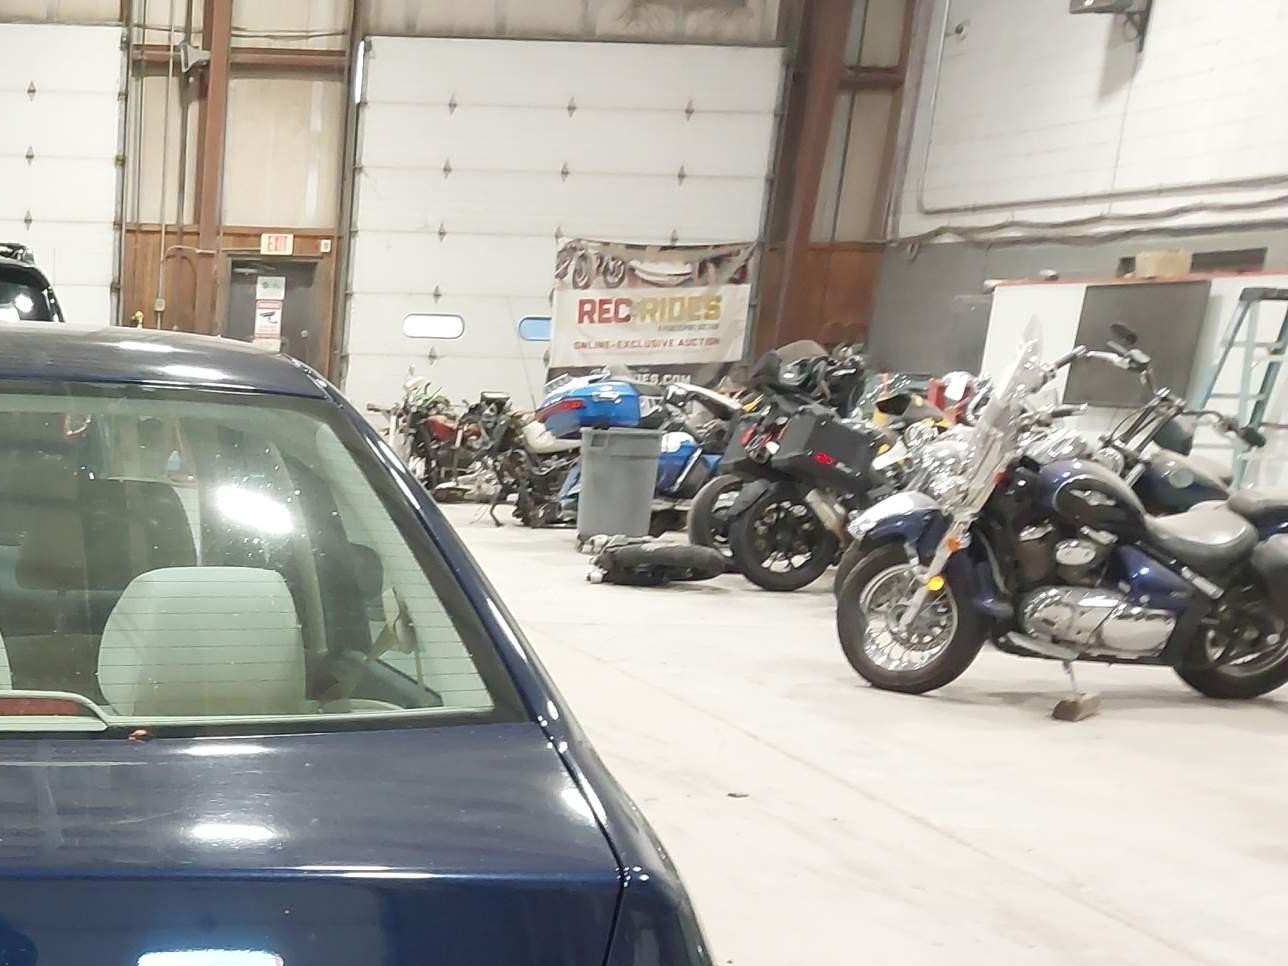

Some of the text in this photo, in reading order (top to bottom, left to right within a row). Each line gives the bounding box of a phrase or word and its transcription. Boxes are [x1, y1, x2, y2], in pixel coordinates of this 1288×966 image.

[577, 295, 722, 325] REC RIDES
[573, 336, 721, 351] ONLINE-EXCLUSIVE AUCTION
